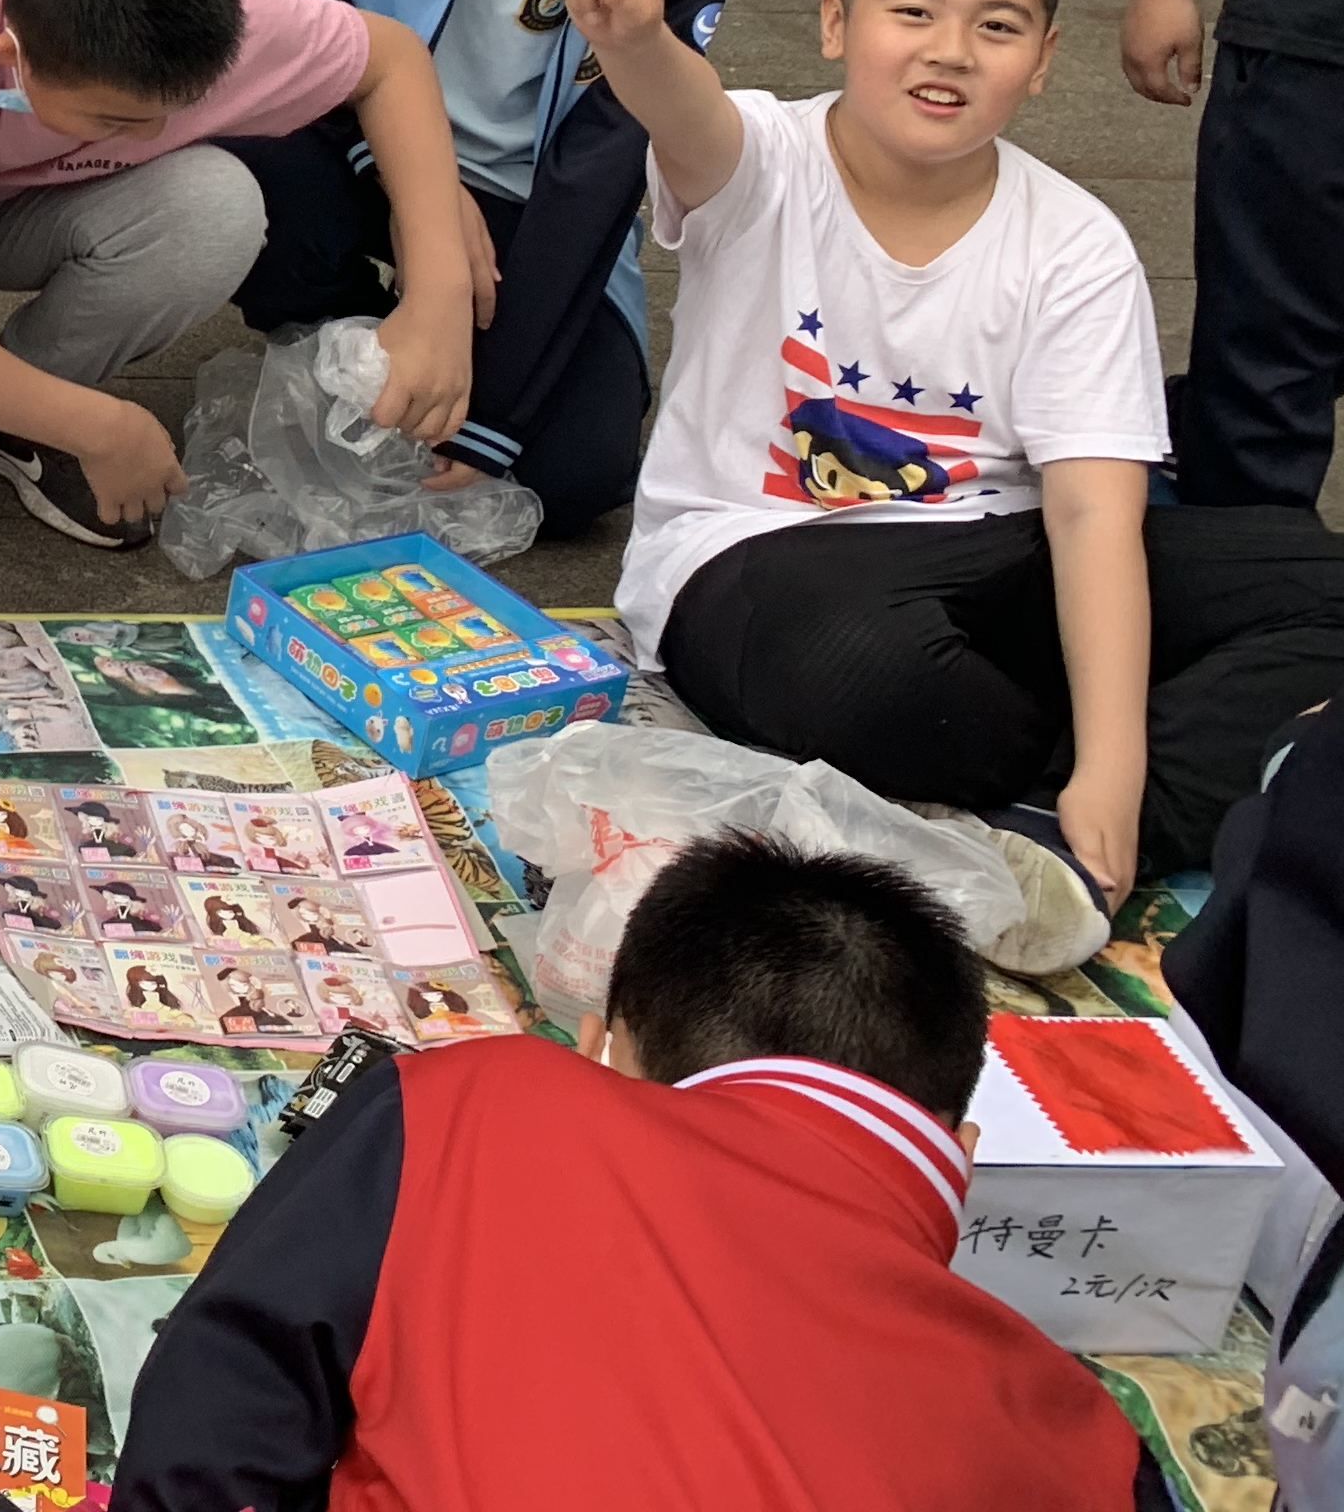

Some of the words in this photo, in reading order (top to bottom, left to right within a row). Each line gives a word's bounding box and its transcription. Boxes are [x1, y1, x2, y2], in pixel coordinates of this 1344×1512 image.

[960, 1214, 1119, 1260] 特曼卡
[1060, 1272, 1178, 1304] 2元/次
